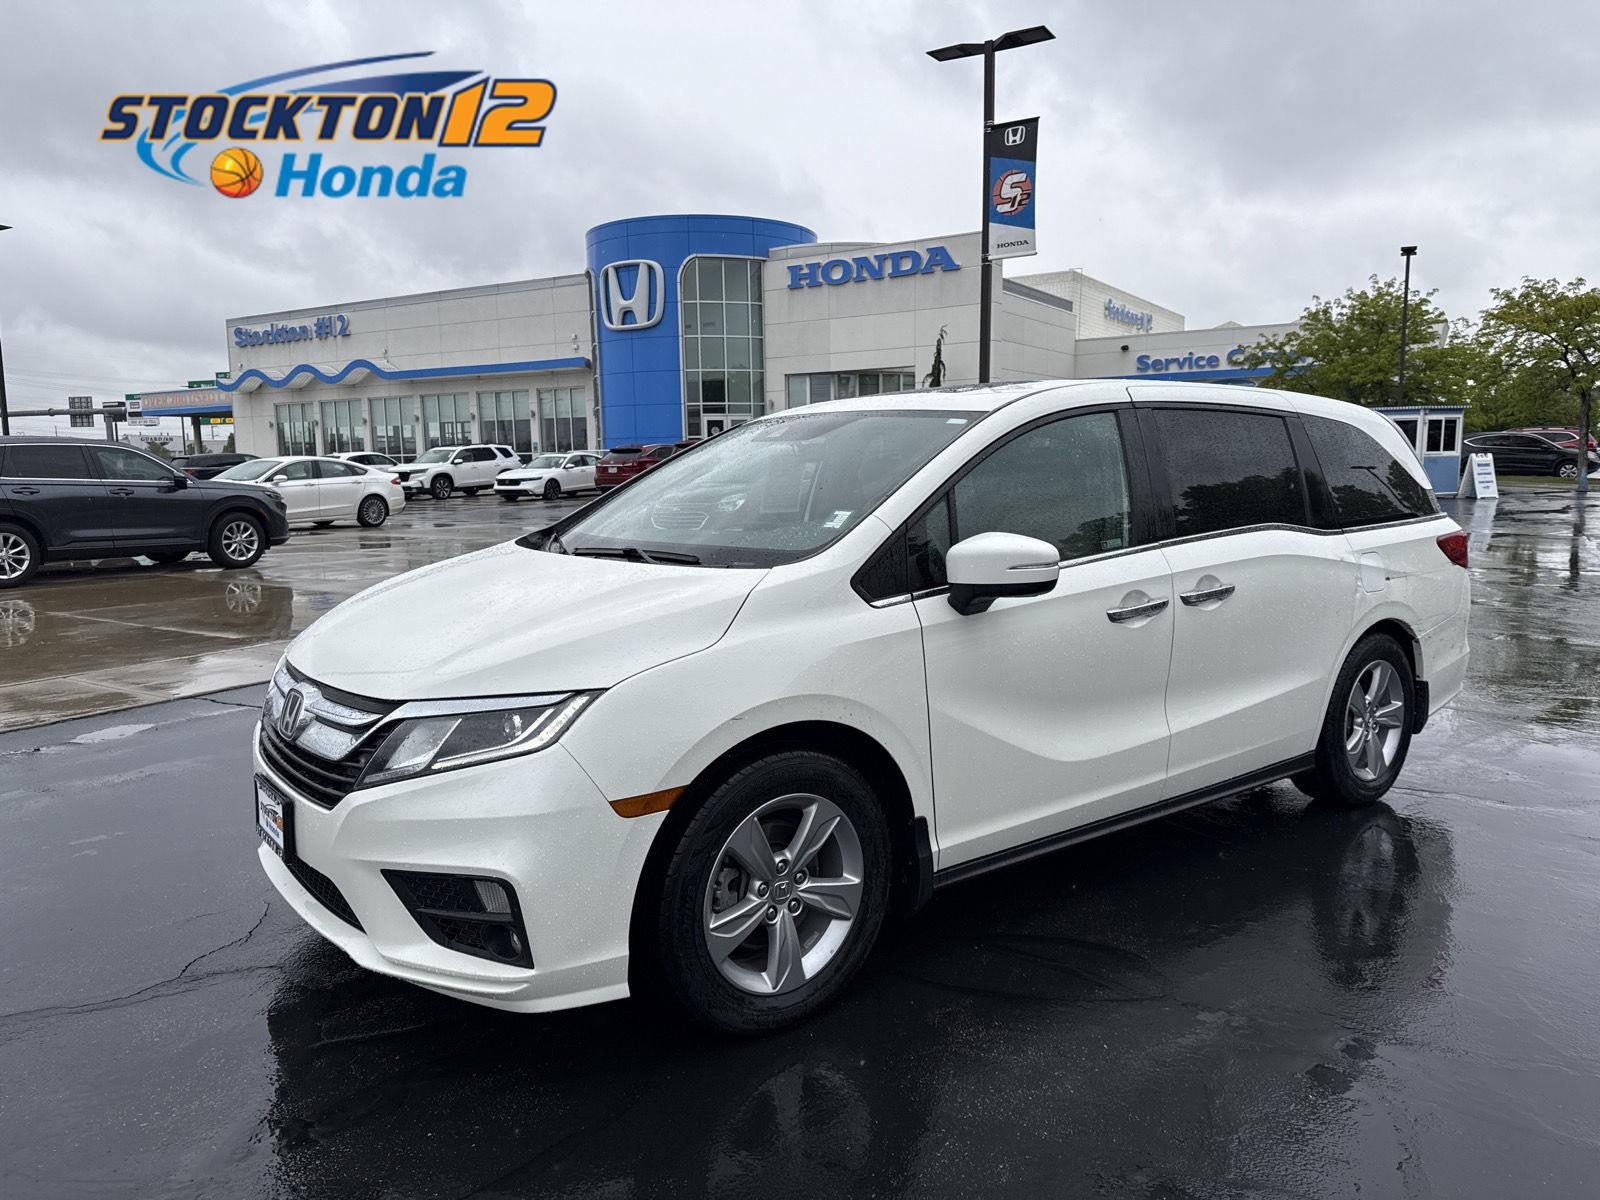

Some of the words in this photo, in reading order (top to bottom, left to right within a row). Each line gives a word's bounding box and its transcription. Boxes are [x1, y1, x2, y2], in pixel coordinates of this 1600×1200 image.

[996, 239, 1030, 249] HONDA
[786, 245, 961, 289] HONDA
[234, 322, 312, 347] Stockton
[314, 312, 350, 340] #12
[1136, 351, 1221, 373] Service
